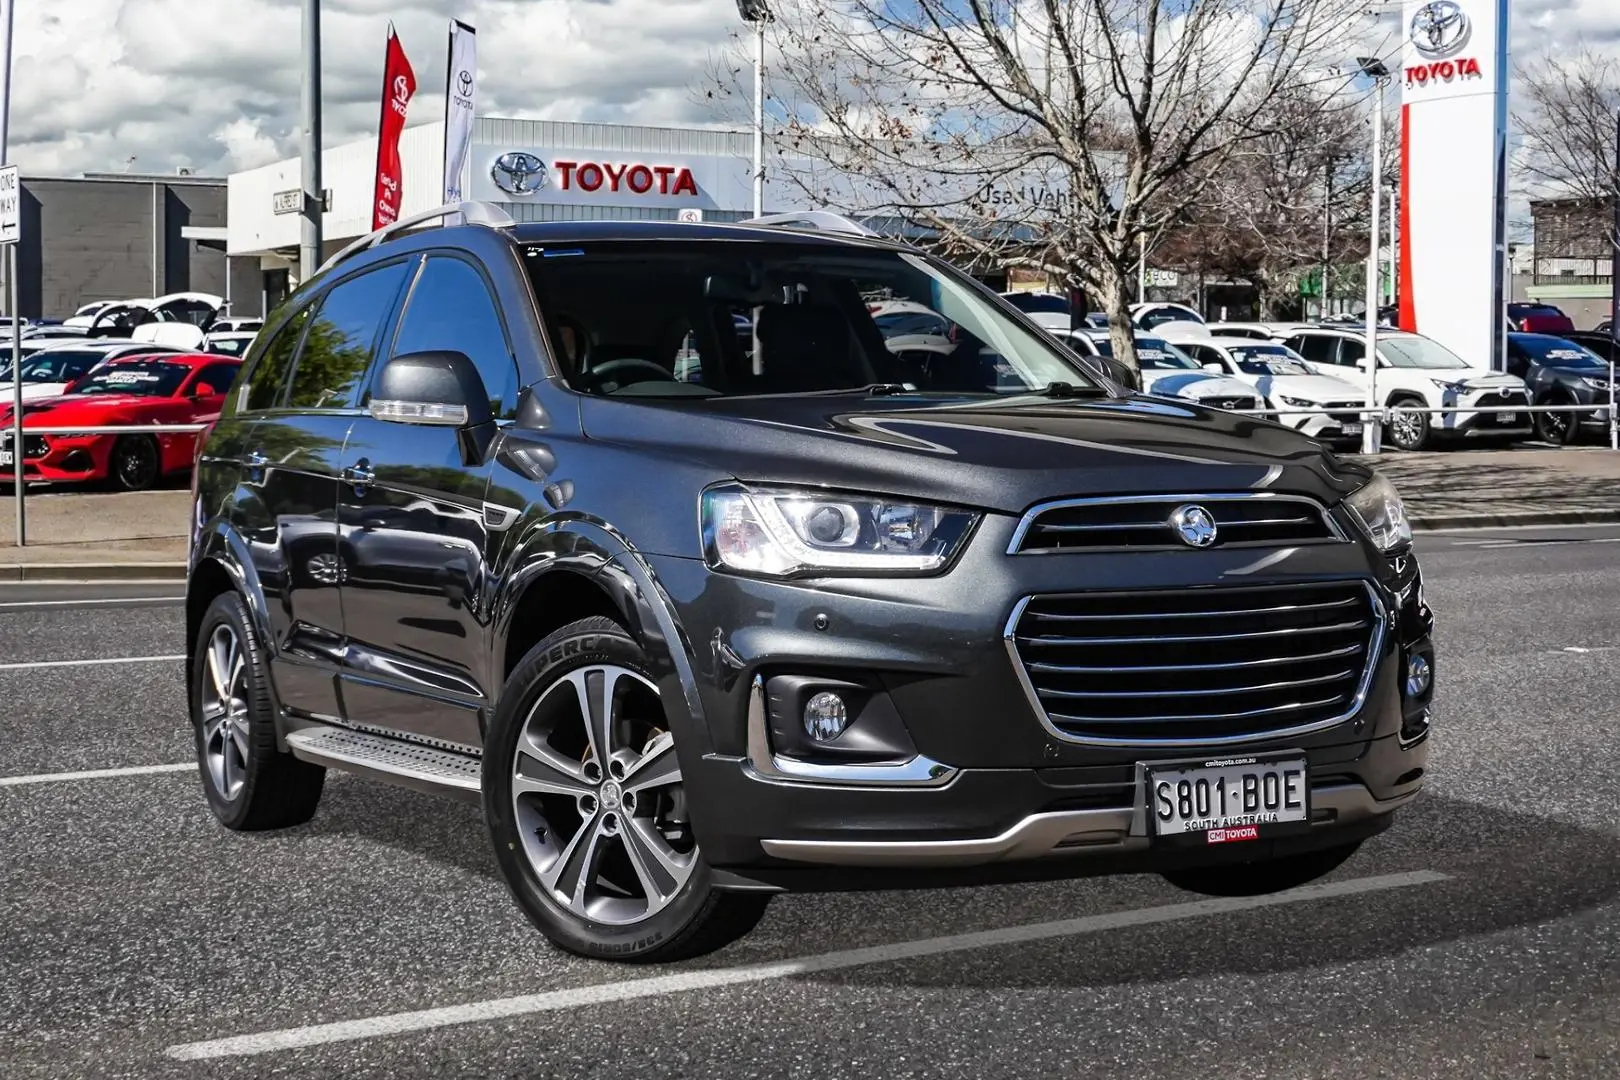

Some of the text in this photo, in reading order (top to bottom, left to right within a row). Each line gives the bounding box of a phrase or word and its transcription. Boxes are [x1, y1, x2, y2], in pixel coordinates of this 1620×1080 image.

[1404, 58, 1480, 83] TOYOTA
[1, 173, 15, 191] ONE
[555, 161, 698, 196] TOYOTA
[1, 196, 17, 213] WAY
[1204, 758, 1257, 768] cmitoyota.com.au
[1184, 813, 1279, 831] SOUTH AUSTRALIA
[1208, 827, 1257, 842] CMI TOYOTA
